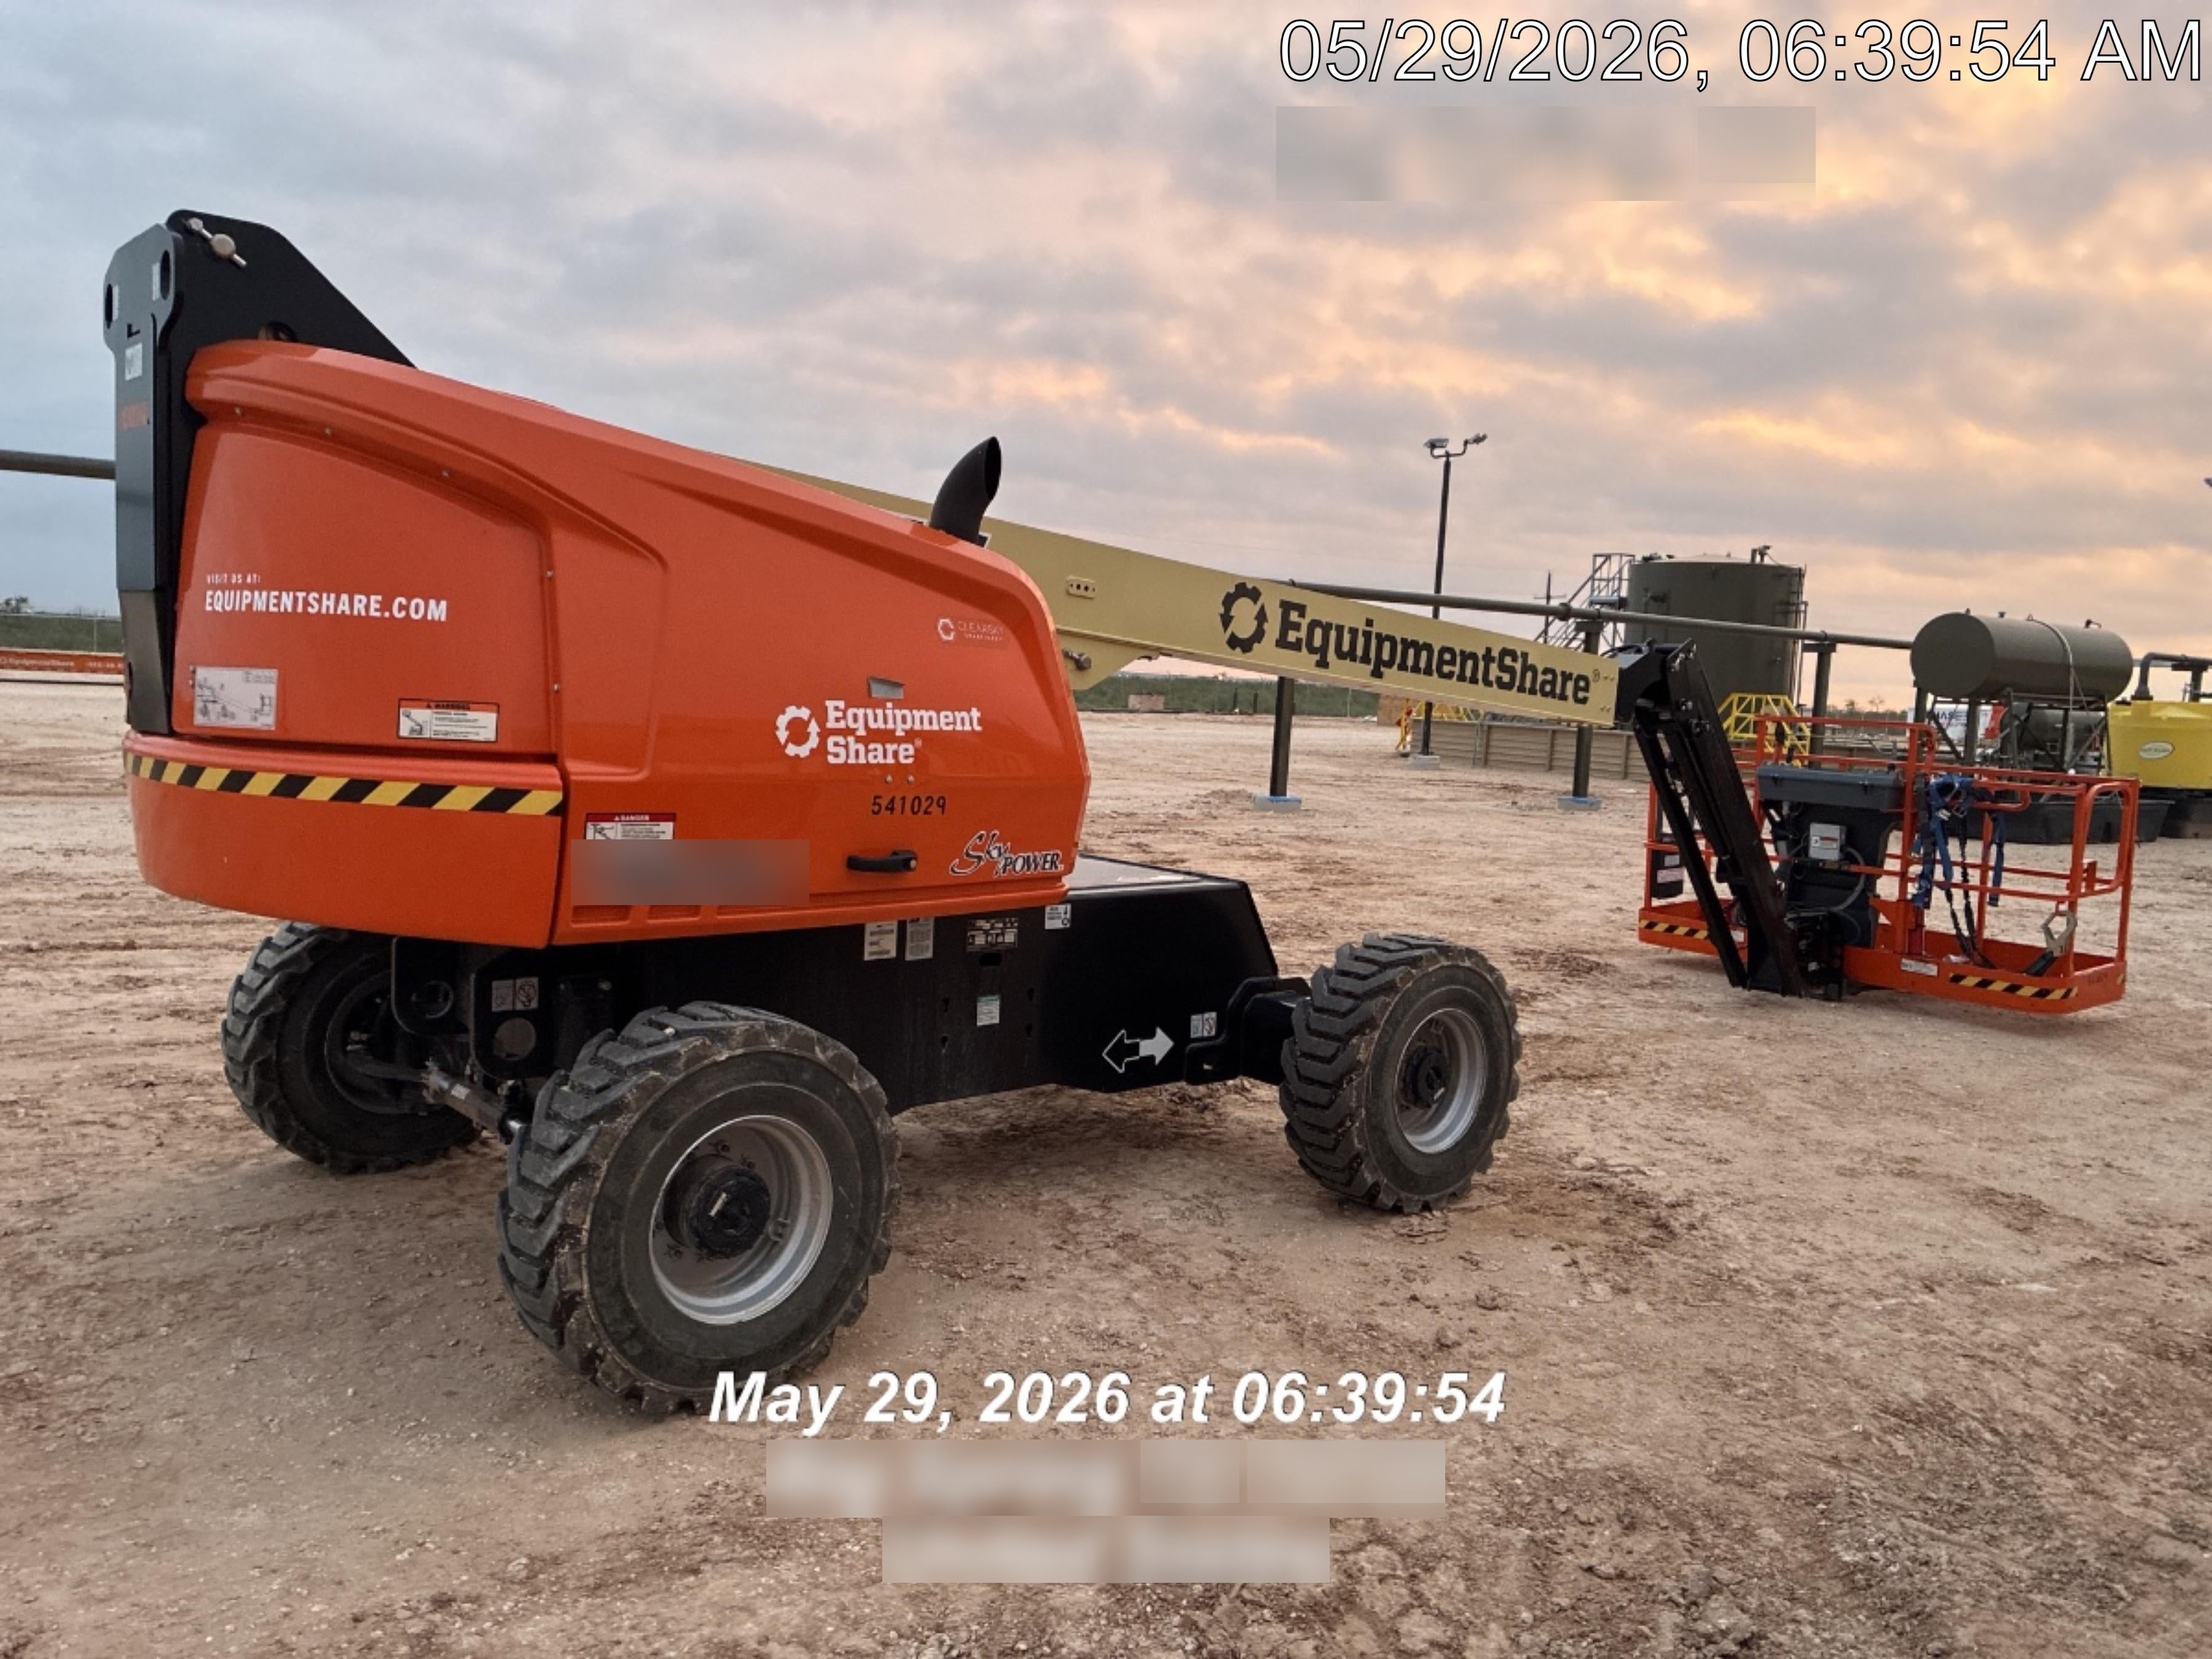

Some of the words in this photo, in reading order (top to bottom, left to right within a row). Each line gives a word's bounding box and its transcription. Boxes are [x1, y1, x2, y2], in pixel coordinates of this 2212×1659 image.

[205, 590, 448, 622] EQUIPMENTSHARE.COM
[825, 700, 983, 736] Equipment
[871, 796, 947, 815] 541029
[949, 830, 1011, 879] Sky
[1002, 850, 1061, 875] POWER
